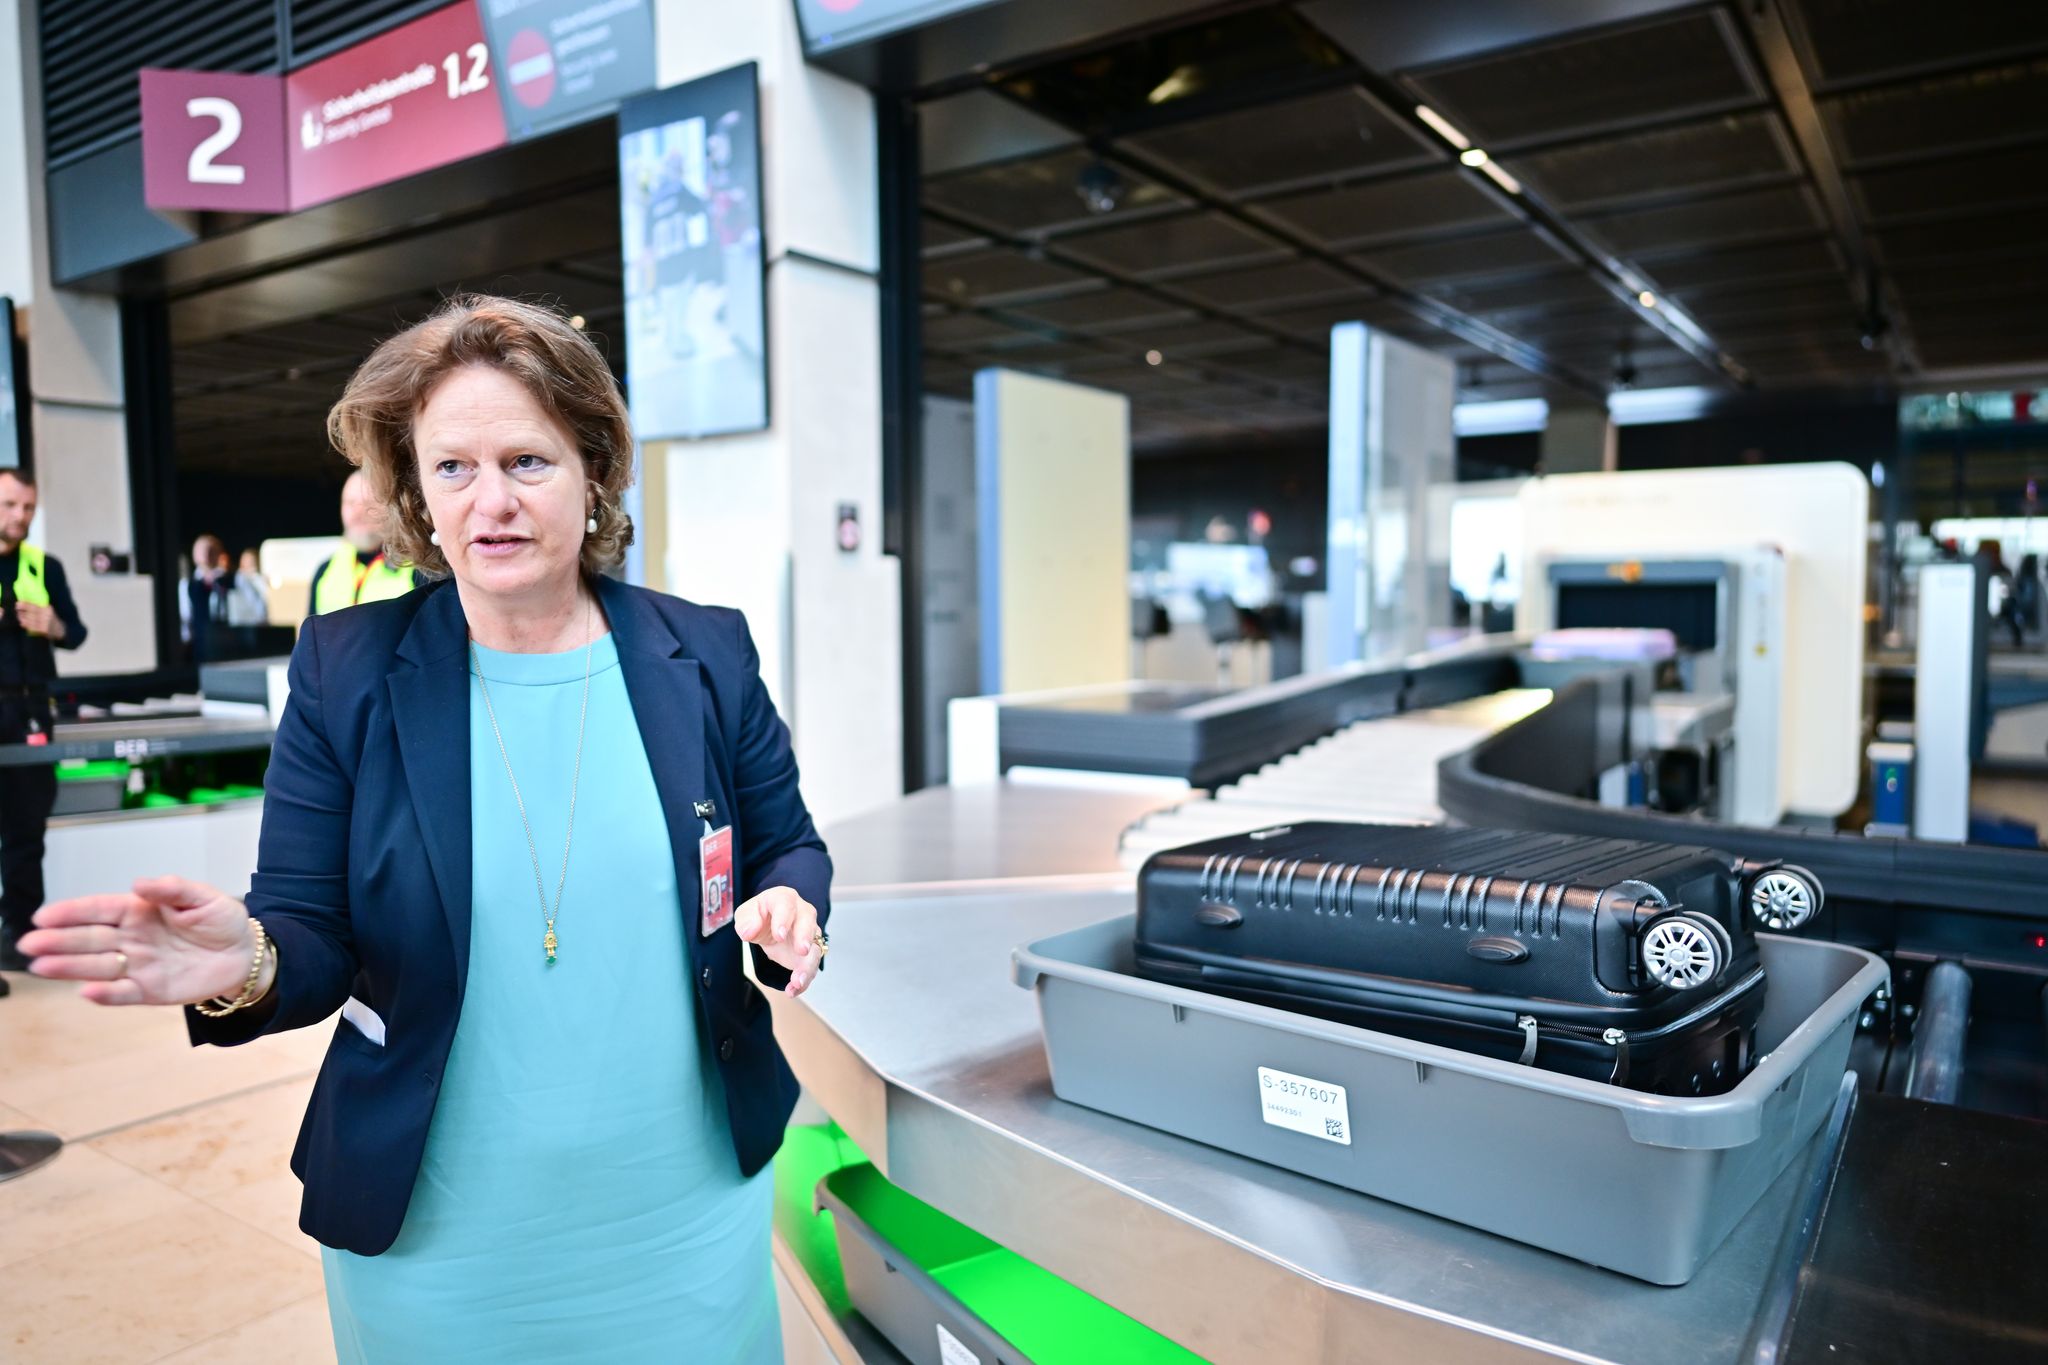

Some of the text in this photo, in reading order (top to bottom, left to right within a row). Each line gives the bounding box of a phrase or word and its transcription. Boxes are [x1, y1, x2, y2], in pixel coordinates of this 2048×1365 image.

[443, 42, 490, 99] 1.2
[186, 96, 245, 184] 2
[1263, 1074, 1338, 1105] S-357607
